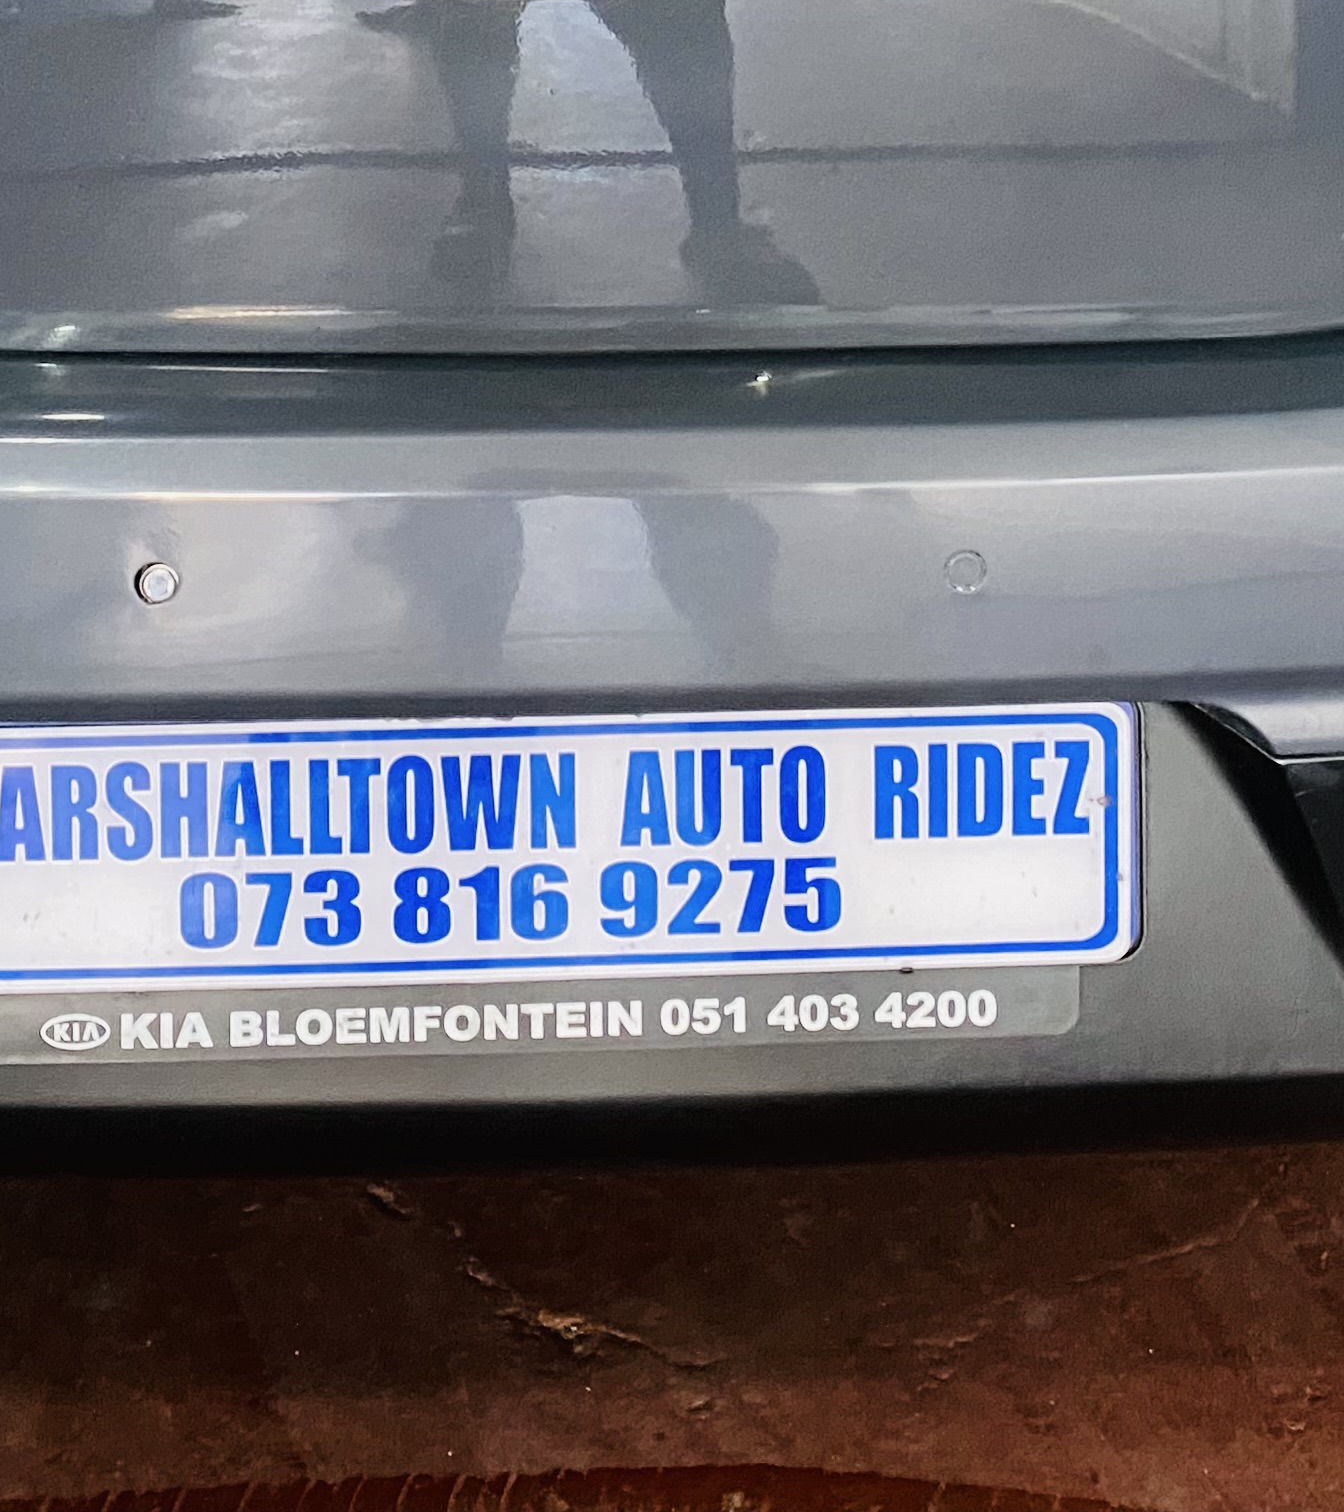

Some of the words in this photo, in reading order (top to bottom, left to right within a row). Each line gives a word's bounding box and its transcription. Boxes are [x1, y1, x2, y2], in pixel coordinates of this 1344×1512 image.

[619, 745, 827, 848] AUTO
[873, 740, 1090, 840] RIDEZ
[178, 869, 363, 949] 073
[393, 863, 569, 945] 816
[599, 856, 842, 939] 9275
[120, 1012, 214, 1050] KIA
[229, 999, 644, 1048] BLOEMFONTEIN
[659, 996, 747, 1036] 051
[767, 993, 860, 1033] 403
[874, 989, 999, 1029] 4200
